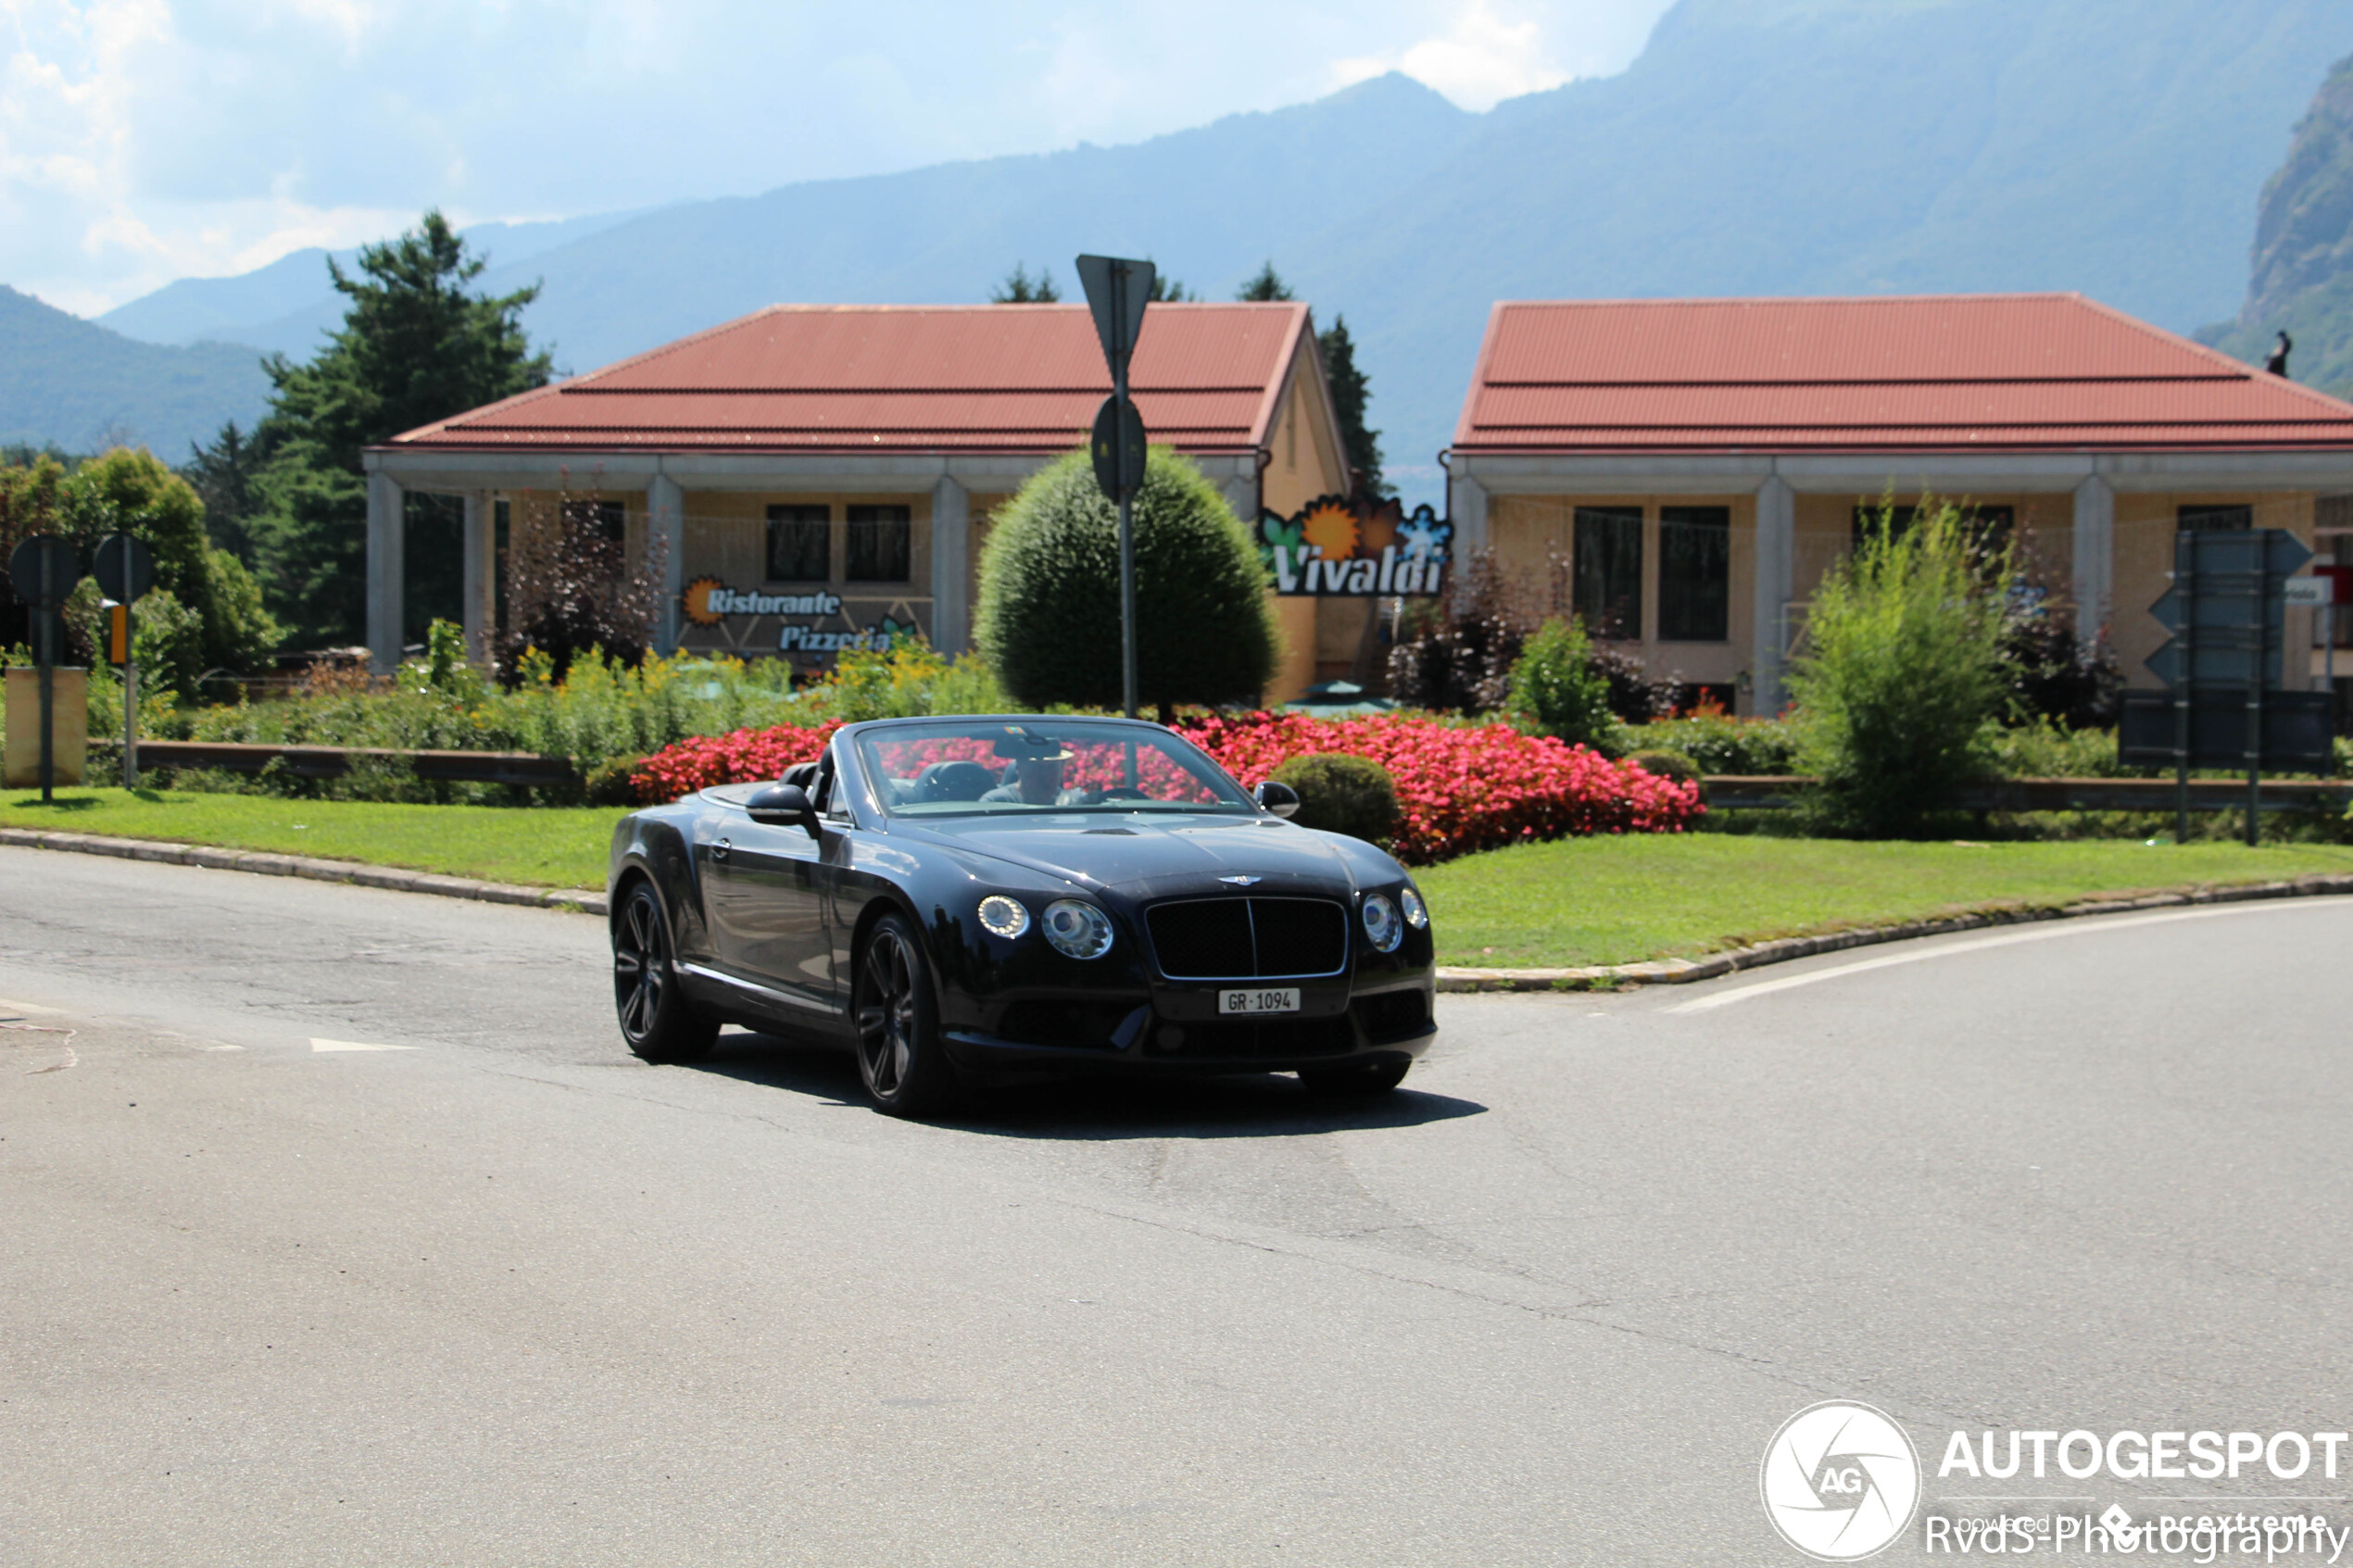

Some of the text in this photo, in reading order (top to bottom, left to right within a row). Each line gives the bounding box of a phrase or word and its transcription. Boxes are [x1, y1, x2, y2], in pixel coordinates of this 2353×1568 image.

[1274, 545, 1444, 594] Vivaldi
[707, 588, 840, 614] Ristorante
[780, 626, 890, 650] Pizzeria
